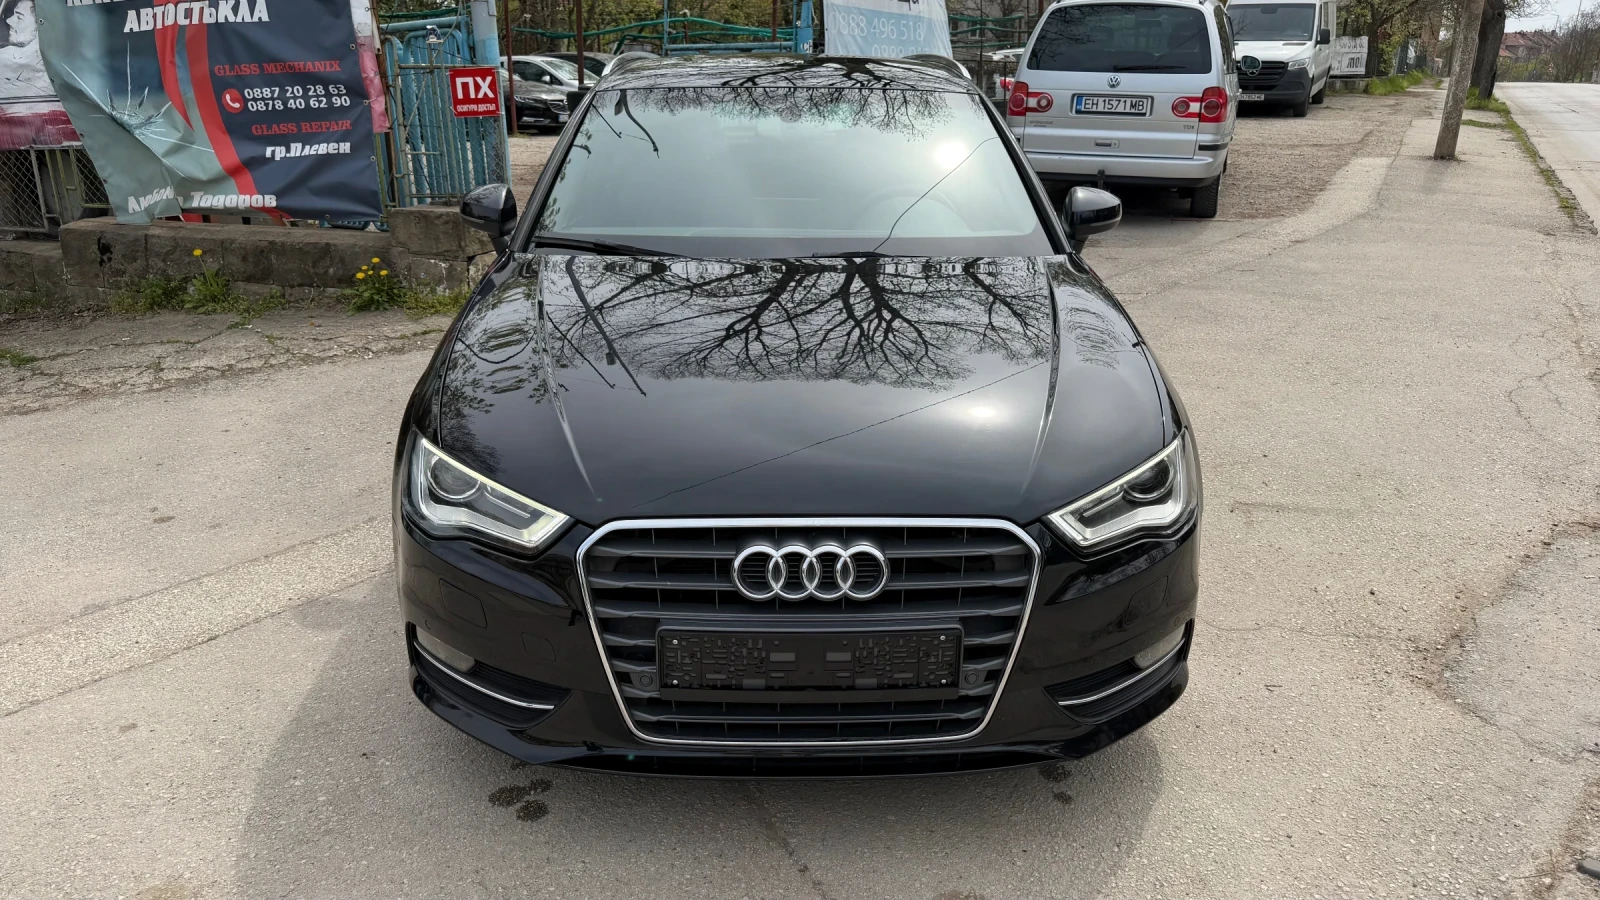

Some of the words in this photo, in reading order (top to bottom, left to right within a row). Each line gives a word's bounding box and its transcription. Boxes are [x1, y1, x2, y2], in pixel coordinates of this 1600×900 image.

[123, 0, 270, 33] АВТОСТЪКЛА
[829, 11, 867, 37] 0888
[871, 18, 897, 39] 496
[900, 20, 924, 41] 518
[214, 63, 260, 76] GLASS
[262, 60, 341, 75] MECHANIX
[244, 87, 280, 99] 0887
[285, 86, 303, 97] 20
[307, 85, 325, 96] 28
[329, 84, 347, 94] 63
[455, 76, 495, 99] ПХ
[247, 100, 284, 112] 0878
[287, 98, 305, 109] 40
[310, 97, 328, 108] 62
[332, 96, 350, 107] 90
[1083, 98, 1099, 110] EH
[1102, 99, 1128, 111] 1571
[1129, 99, 1145, 111] MB
[251, 122, 298, 135] GLASS
[301, 119, 352, 133] REPAIR
[266, 142, 351, 161] гр.Плевен
[191, 191, 277, 209] Тодоров
